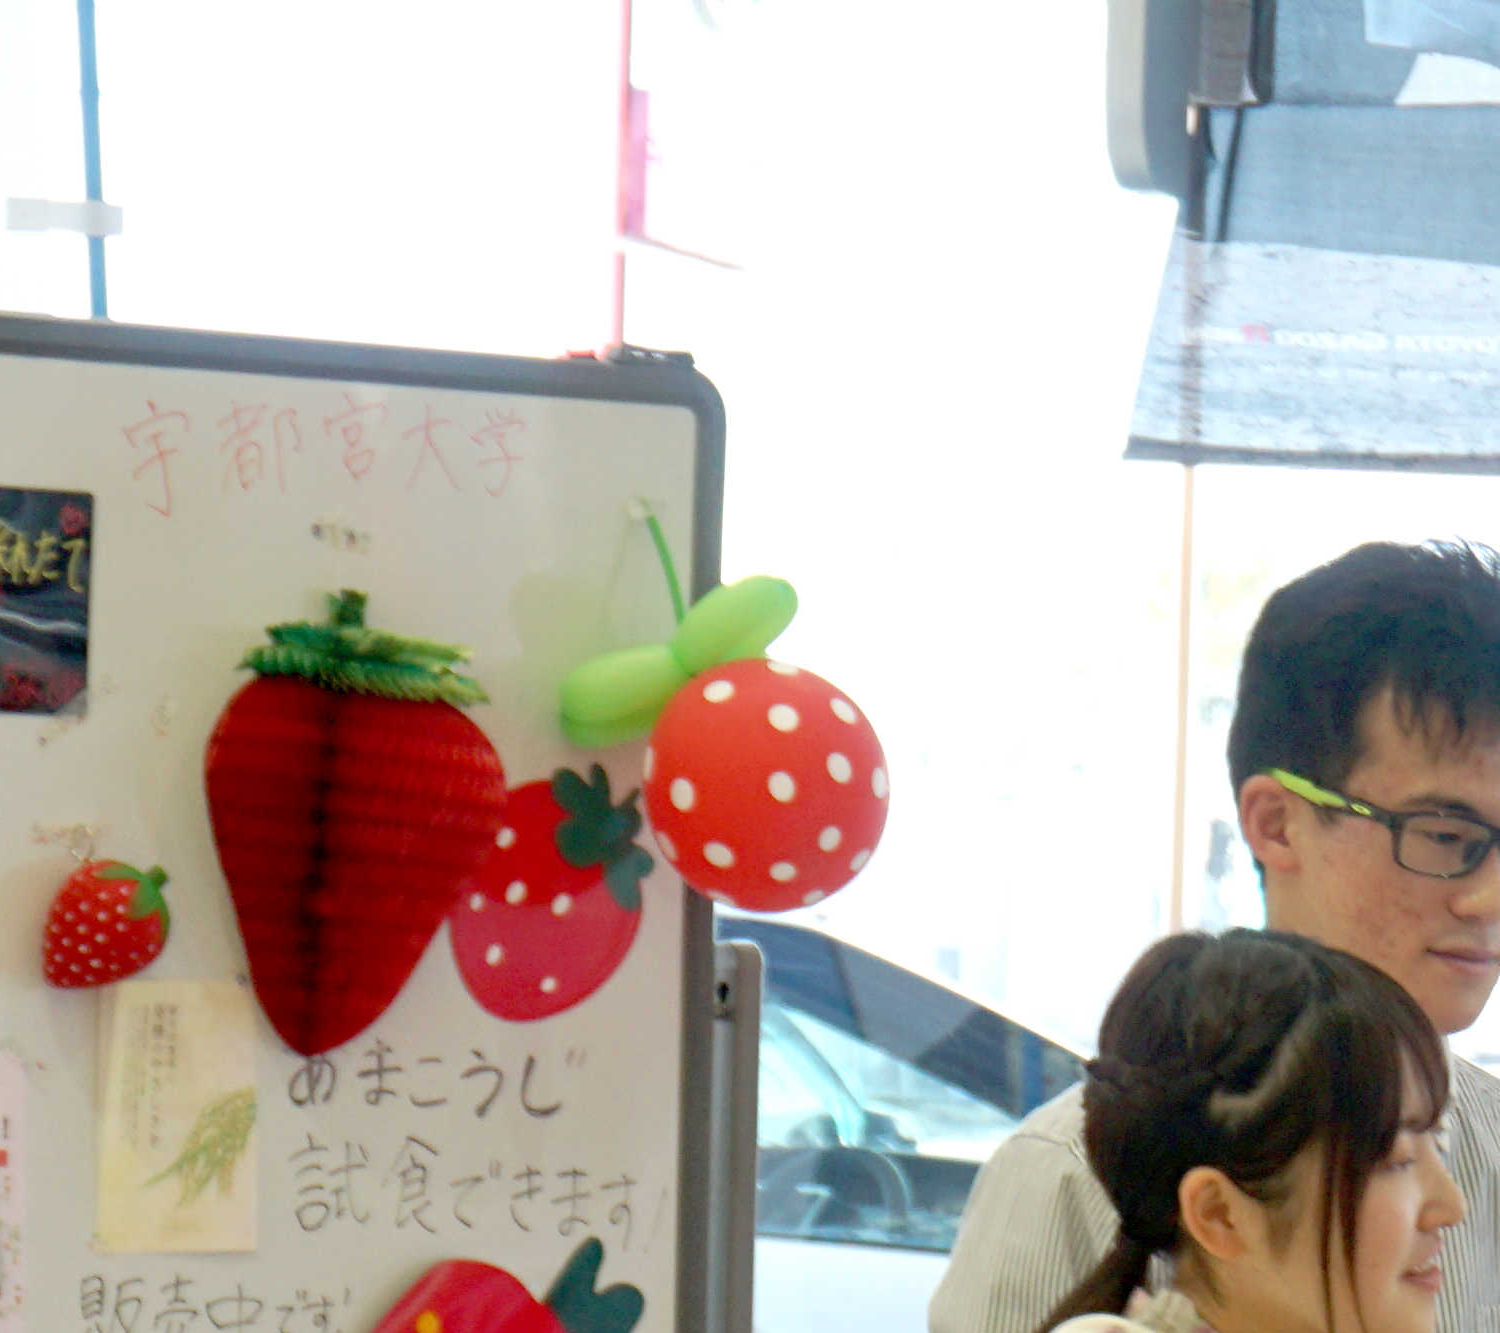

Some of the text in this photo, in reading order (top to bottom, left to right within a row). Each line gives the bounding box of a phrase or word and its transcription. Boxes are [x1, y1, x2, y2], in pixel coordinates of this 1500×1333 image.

[124, 392, 531, 518] 宇都宮大学
[288, 1131, 668, 1256] 試食できます!
